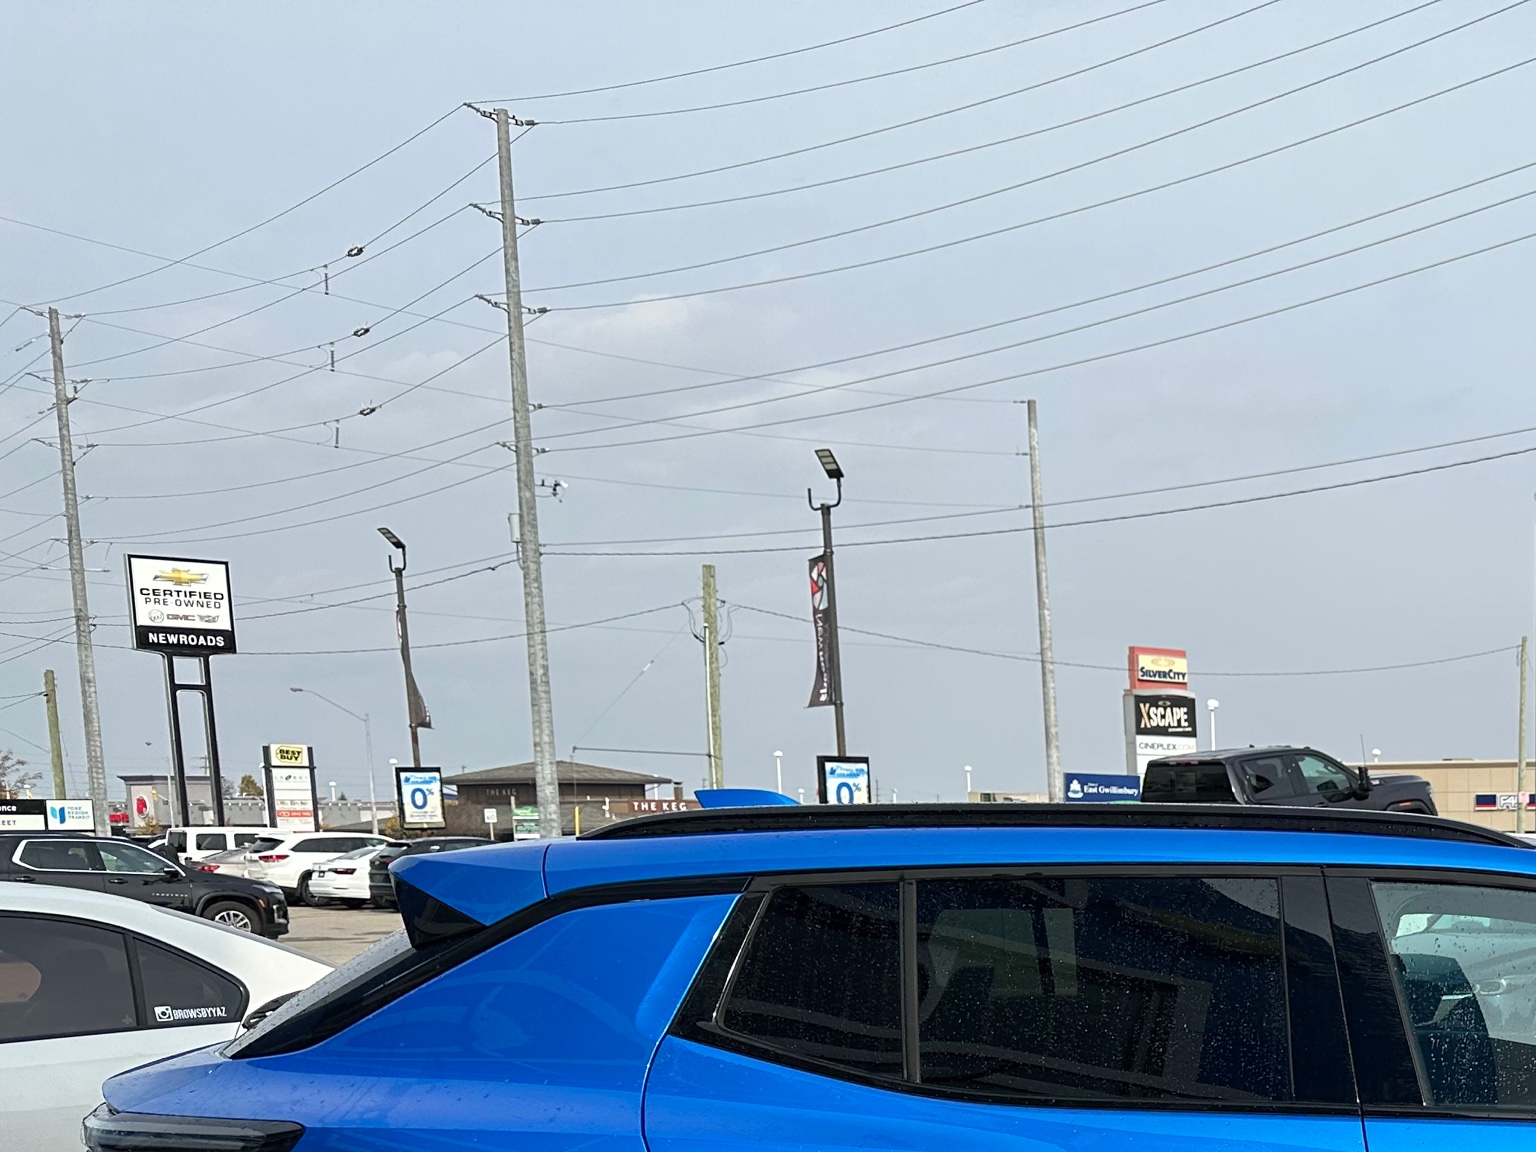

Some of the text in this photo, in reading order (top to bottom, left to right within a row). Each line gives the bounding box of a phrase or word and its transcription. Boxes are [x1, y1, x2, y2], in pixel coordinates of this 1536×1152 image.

[140, 588, 224, 600] CERTIFIED
[145, 597, 221, 609] PRE-OWNED
[166, 613, 196, 621] GMC
[148, 632, 225, 647] NEWROADS
[279, 748, 302, 756] BEST
[1083, 785, 1098, 794] East
[633, 801, 687, 811] THE KEG
[173, 1006, 227, 1020] BROWSBYYAZ
